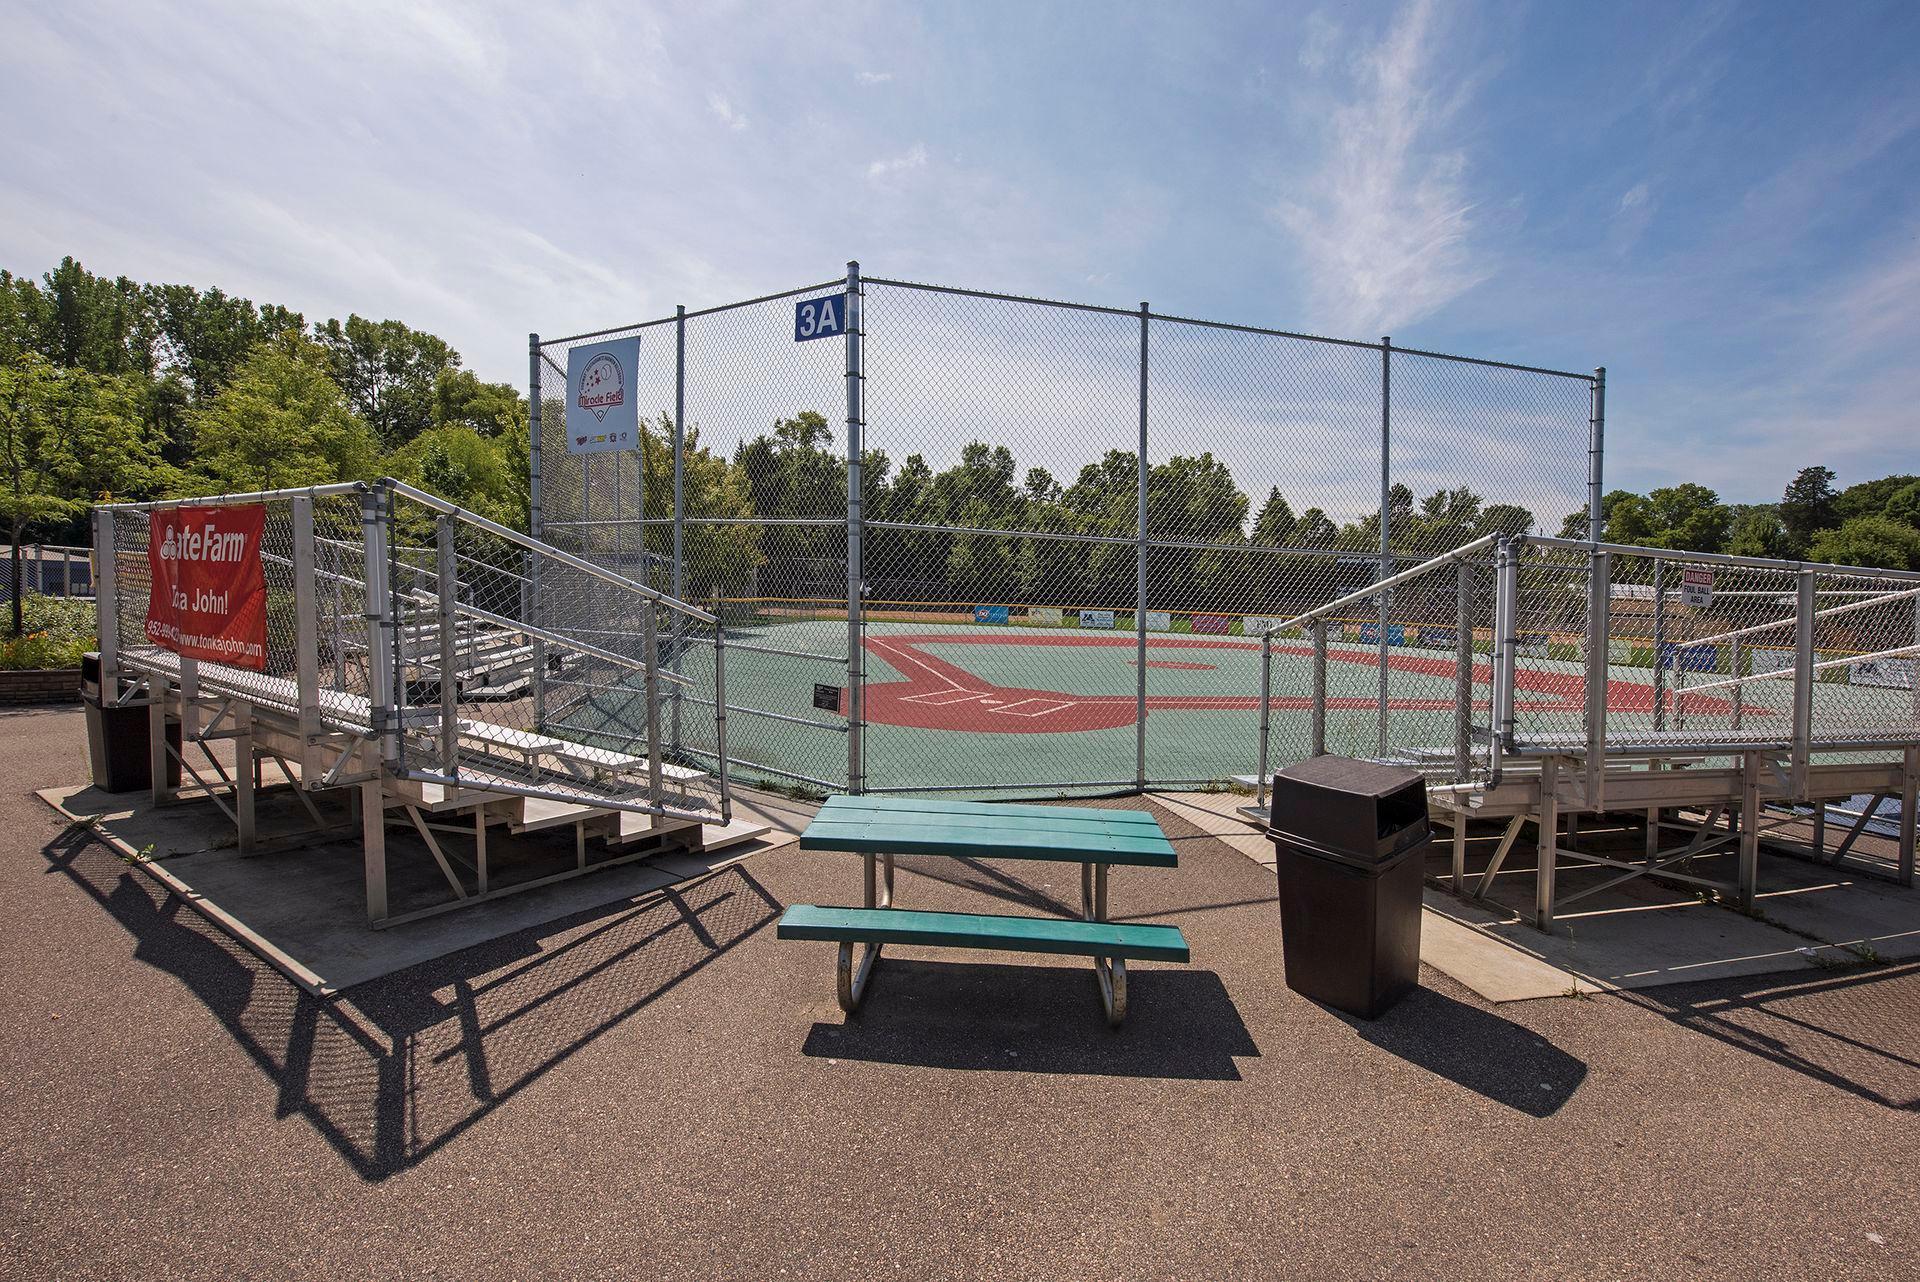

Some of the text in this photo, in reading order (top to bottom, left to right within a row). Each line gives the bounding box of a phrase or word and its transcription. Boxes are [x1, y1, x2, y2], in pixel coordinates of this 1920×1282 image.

[800, 299, 838, 337] 3A
[605, 391, 623, 402] Field
[201, 524, 246, 562] Farm
[1685, 571, 1712, 584] DANGER
[1684, 585, 1710, 595] FOUL BALL
[192, 587, 228, 615] John!
[1690, 595, 1704, 604] AREA
